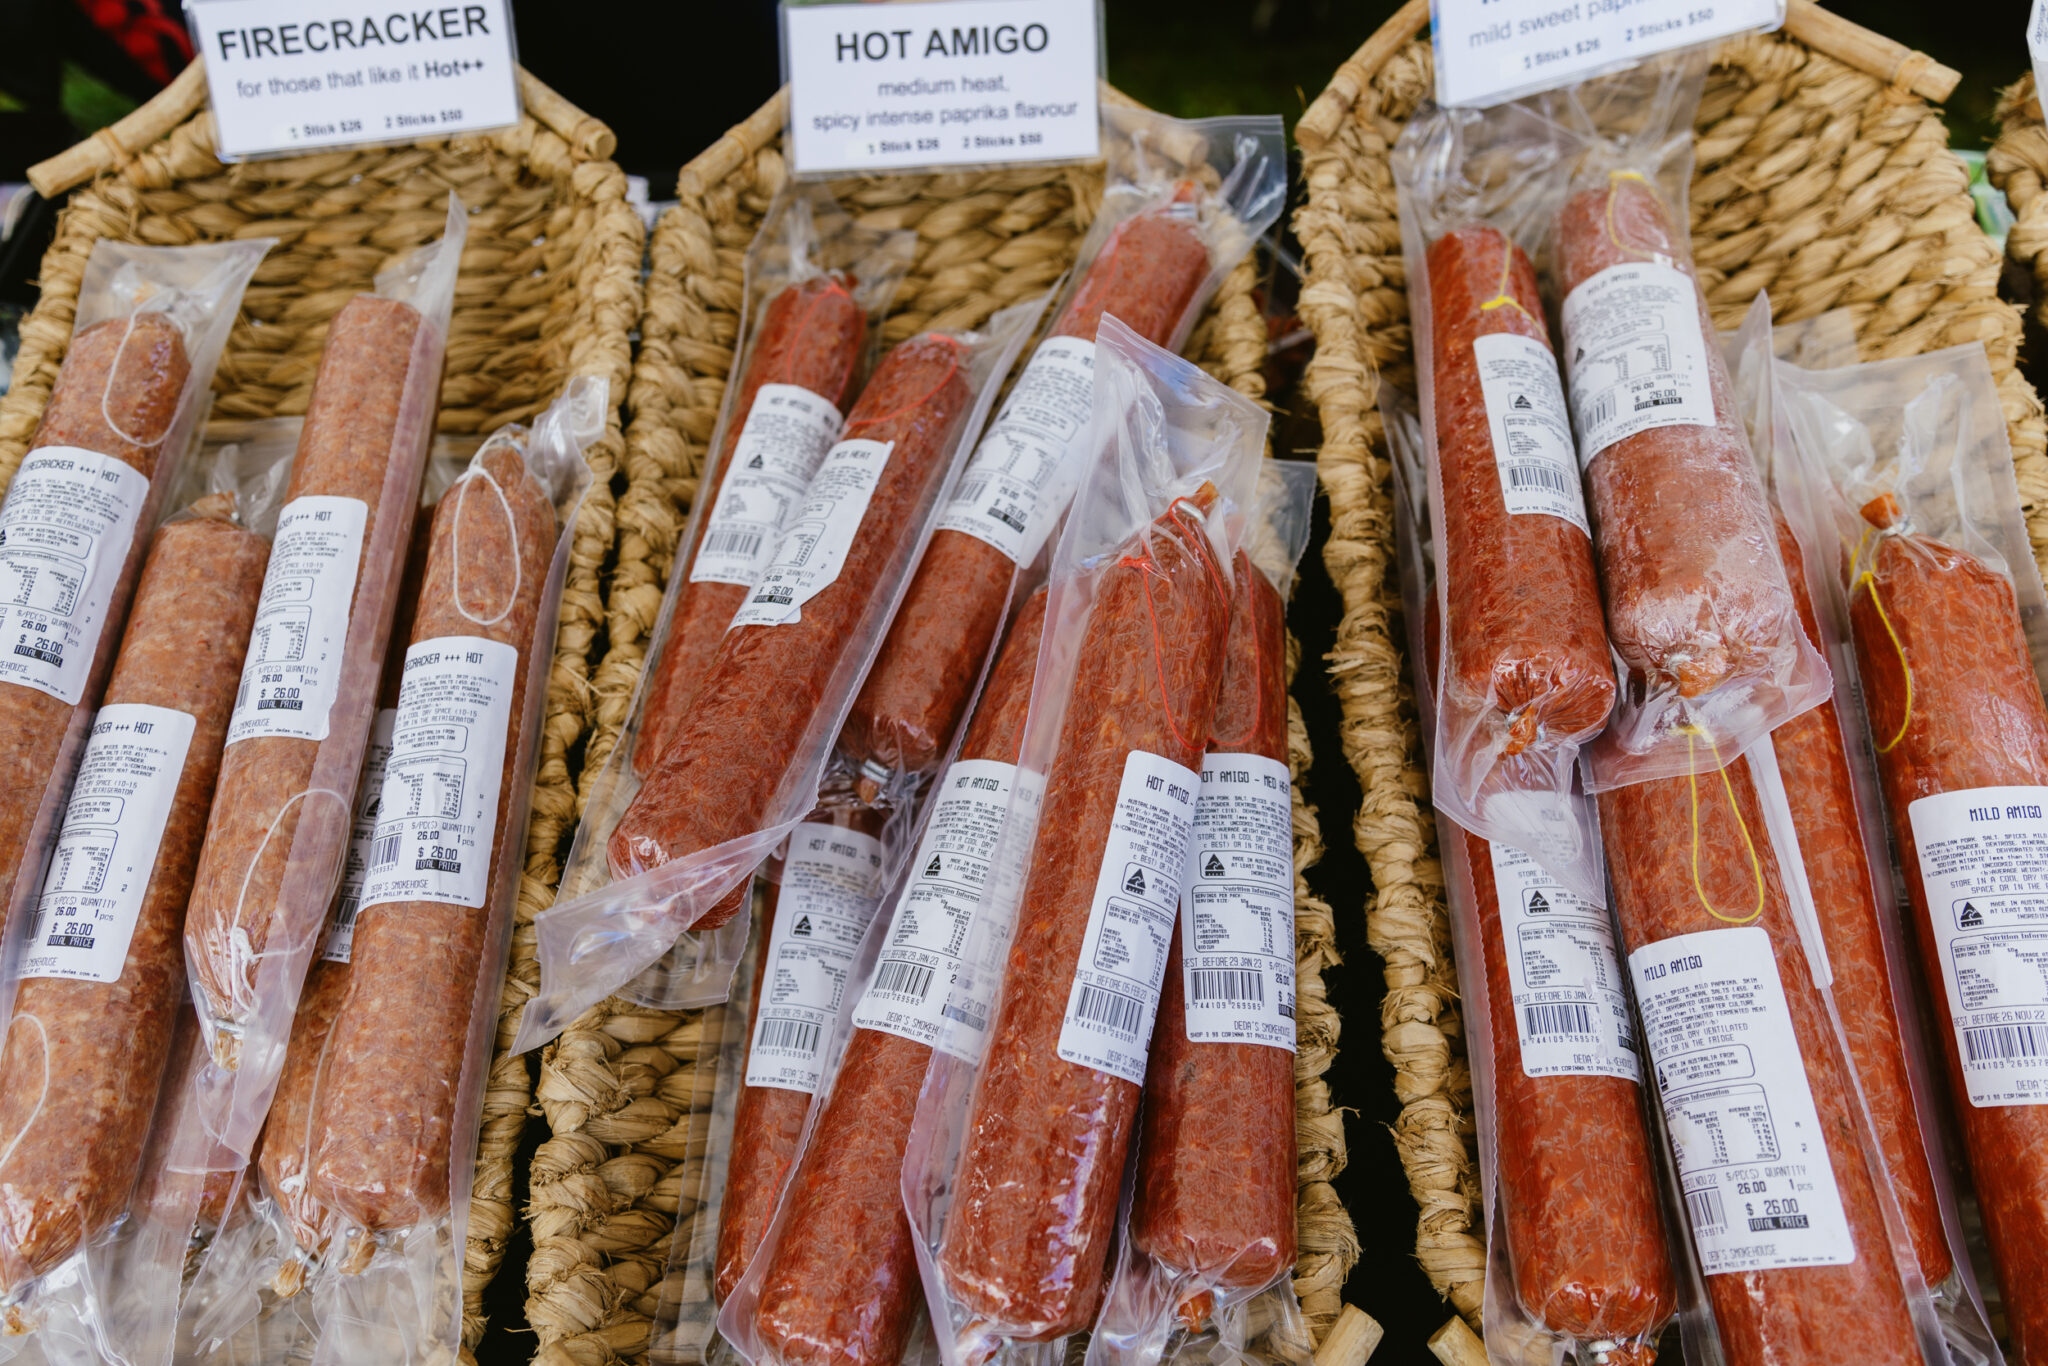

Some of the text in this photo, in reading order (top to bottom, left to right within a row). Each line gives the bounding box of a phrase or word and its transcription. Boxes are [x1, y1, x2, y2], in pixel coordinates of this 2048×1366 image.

[218, 6, 490, 60] FIRECRACKER
[1469, 21, 1512, 48] mild
[1518, 5, 1581, 35] sweet
[836, 23, 1049, 62] HOT AMIGO
[1535, 47, 1570, 66] Stick
[1638, 19, 1682, 38] Sticks
[237, 59, 484, 98] for those that like it Hot++
[877, 78, 955, 97] medium
[813, 101, 1078, 132] spicy intense paprika flavour
[304, 123, 335, 138] Stick
[396, 113, 436, 127] Sticks
[880, 141, 912, 153] Stick
[974, 135, 1015, 148] Sticks
[101, 470, 120, 484] HOT
[315, 512, 332, 521] HOT
[21, 620, 47, 632] 26.00
[51, 618, 82, 636] QUANTITY
[19, 634, 63, 655] $ 26.00
[15, 645, 63, 667] TOTAL PRICE
[466, 652, 483, 664] HOT
[285, 665, 319, 675] QUANTITY
[260, 687, 300, 699] $ 26.00
[280, 700, 303, 711] PRICE
[134, 722, 154, 734] HOT
[955, 777, 999, 791] HOT AMIGO
[1201, 771, 1277, 789] OT AMIGO MED
[1146, 775, 1189, 804] HOT AMIGO
[1970, 806, 2042, 822] MILD AMIGO
[417, 831, 439, 840] 26.00
[442, 823, 475, 834] QUANTITY
[808, 838, 826, 851] HOT
[418, 846, 457, 860] $ 26.00
[416, 859, 461, 873] TOTAL PRICE
[1950, 879, 1973, 889] STORE
[1977, 877, 1987, 885] IN
[1971, 885, 1995, 894] SPACE
[1999, 884, 2010, 892] OR
[2027, 882, 2041, 890] THE
[80, 897, 117, 909] QUANTITY
[55, 907, 77, 916] 26.00
[51, 922, 94, 936] $ 26.00
[47, 935, 95, 949] TOTAL PRICE
[1202, 957, 1230, 967] BEFORE
[1644, 955, 1703, 981] MILD AMIGO
[1097, 975, 1121, 992] BEFORE
[1535, 991, 1561, 1002] BEFORE
[886, 1011, 911, 1026] DEDA'S
[1972, 1012, 2000, 1025] BEFORE
[1234, 1021, 1259, 1031] DEDA'S
[1704, 1023, 1749, 1035] VENTILATED
[1708, 1034, 1735, 1043] FRIDGE
[1764, 1165, 1808, 1178] QUANTITY
[1737, 1181, 1767, 1195] 26.00
[1745, 1198, 1800, 1217] $ 26.00
[1748, 1215, 1810, 1232] TOTAL PRICE
